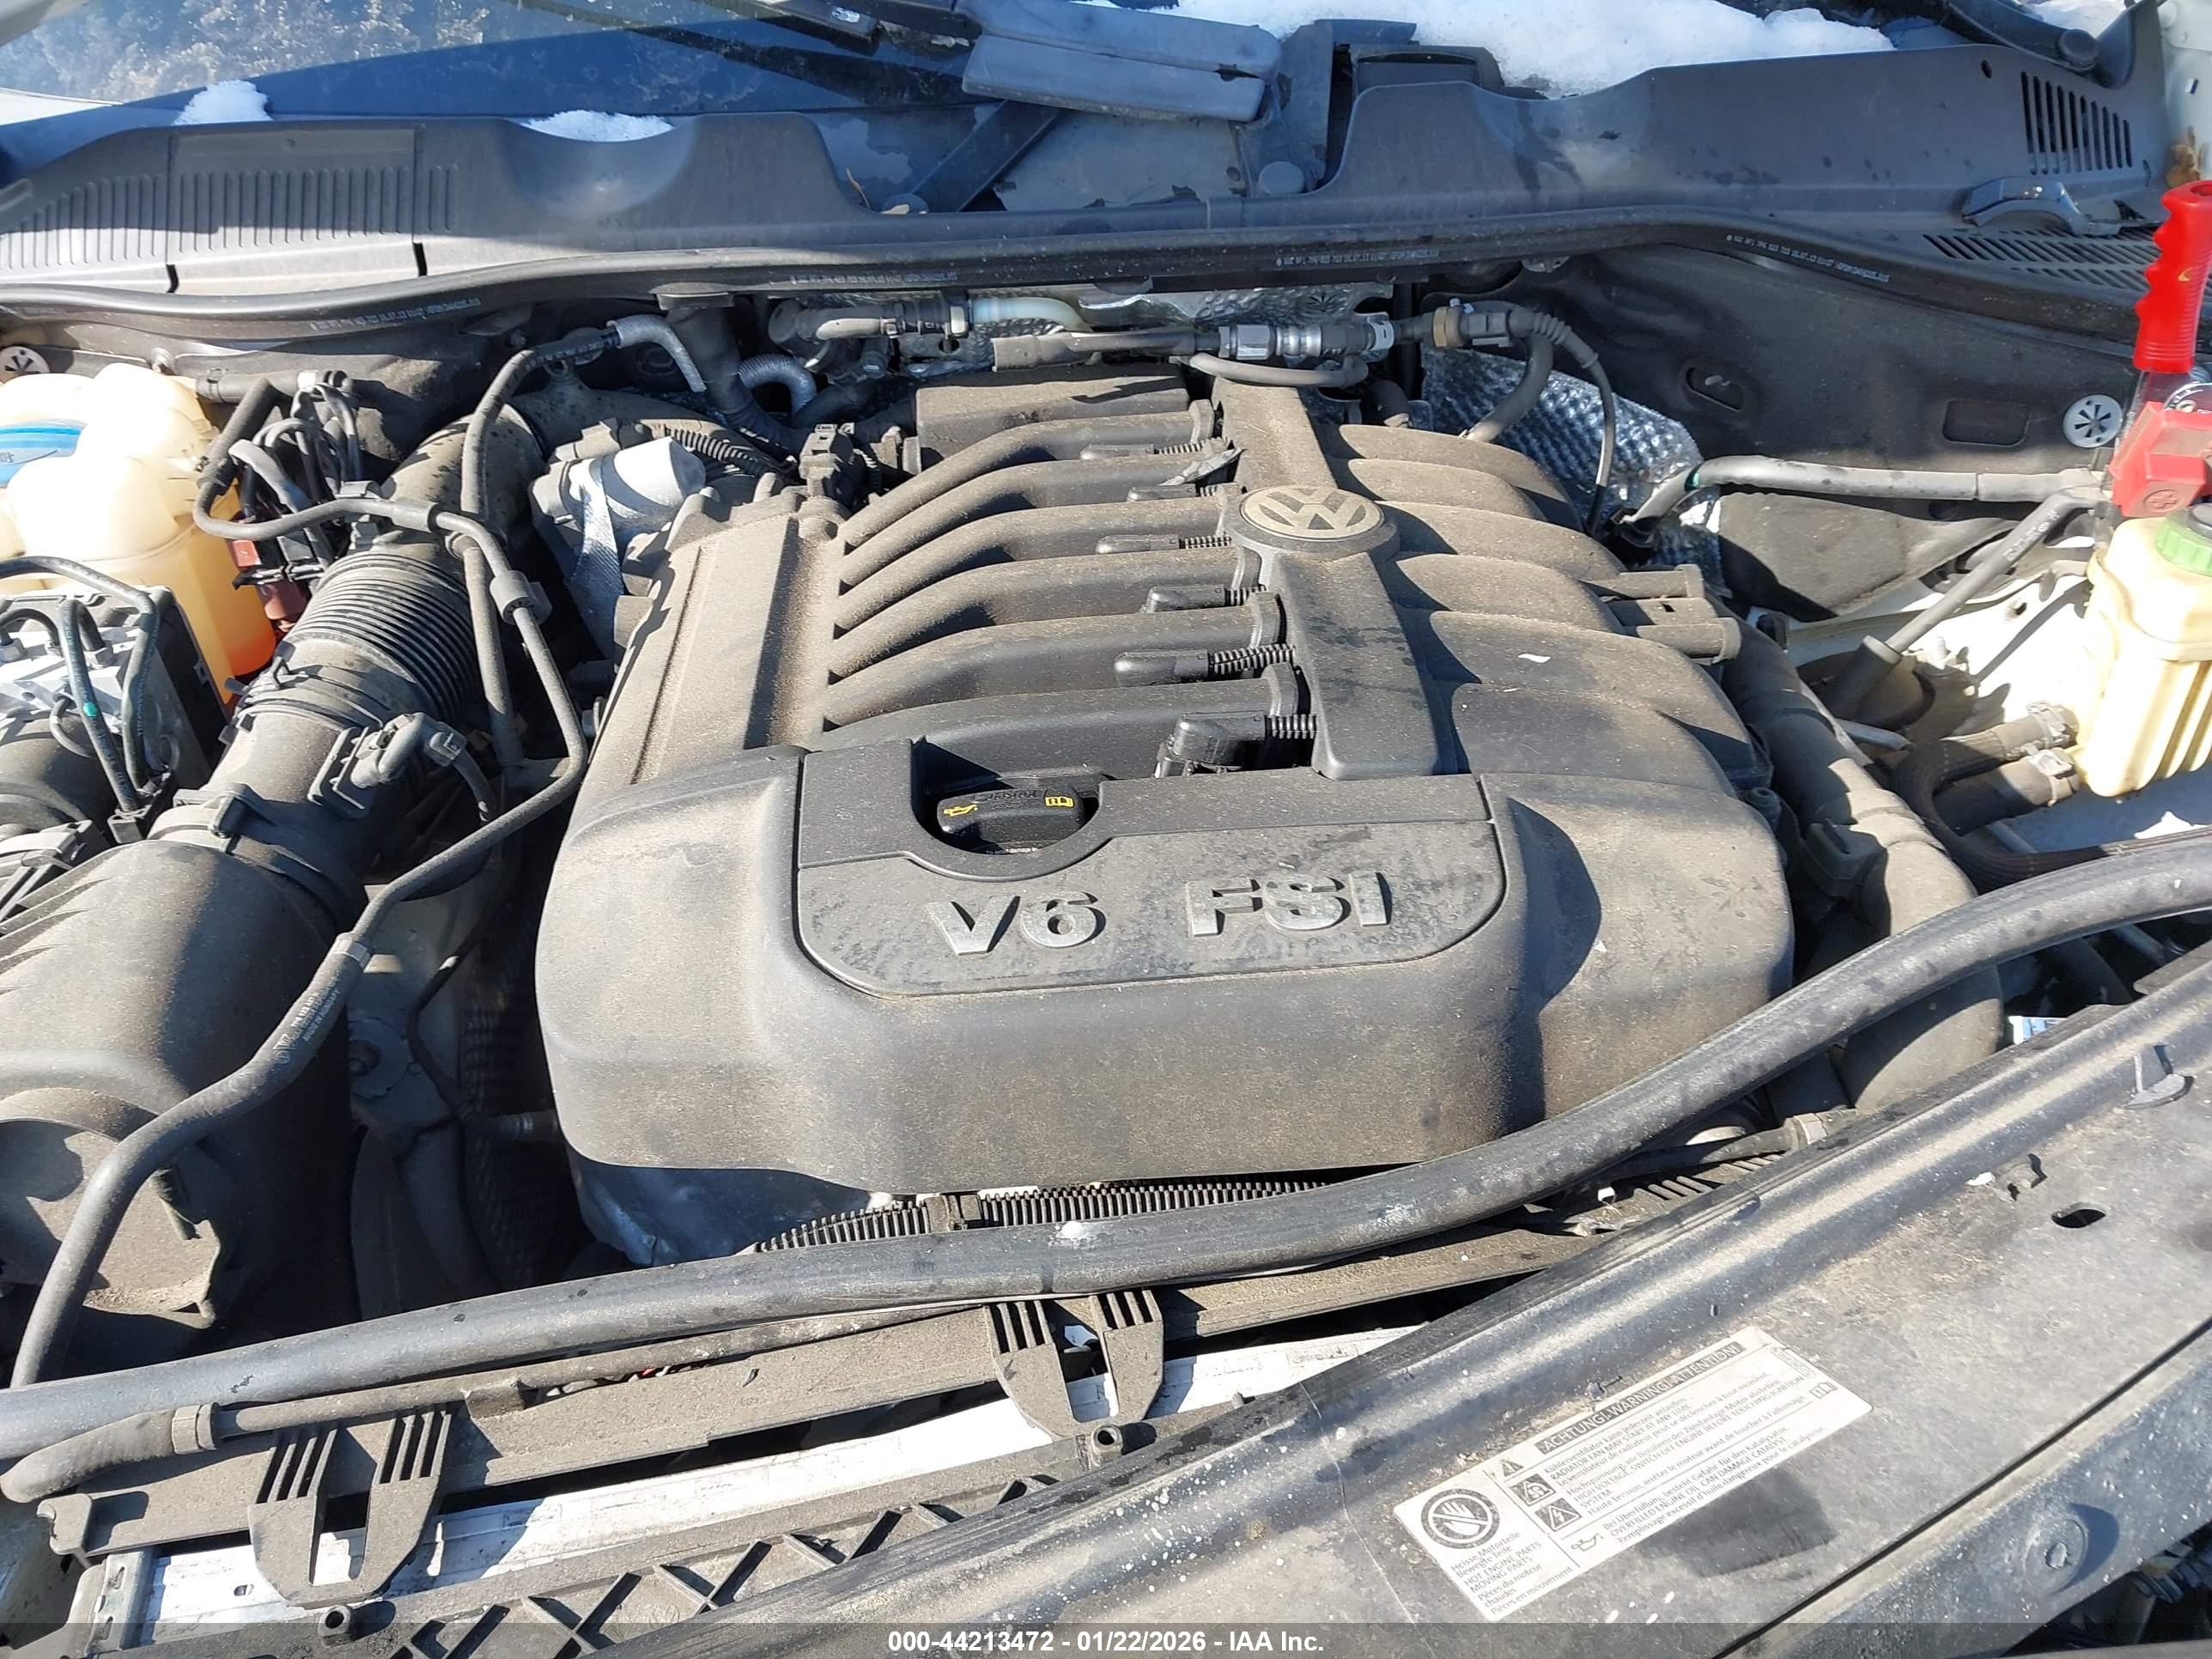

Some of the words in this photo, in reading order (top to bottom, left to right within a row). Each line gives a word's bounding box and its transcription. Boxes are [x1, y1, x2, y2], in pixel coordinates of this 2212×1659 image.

[924, 890, 1105, 957] V6
[1186, 872, 1393, 939] FSI
[1540, 1411, 1611, 1450] ACHTUNG!
[1606, 1379, 1674, 1416] WARNING!
[1668, 1344, 1741, 1383] ATTENTION!
[1723, 1395, 1749, 1411] Motor
[1549, 1456, 1591, 1480] RADIATOR
[1587, 1448, 1607, 1461] FAN
[1603, 1439, 1624, 1452] MAY
[1621, 1427, 1647, 1442] START
[1644, 1421, 1657, 1430] AT
[1653, 1413, 1674, 1425] ANY
[1571, 1486, 1597, 1502] HIGH
[1629, 1451, 1663, 1472] SWITCH
[1658, 1443, 1677, 1455] OFF
[1673, 1429, 1705, 1448] ENGINE
[1702, 1414, 1732, 1431] BEFORE
[1730, 1393, 1773, 1416] TOUCHING
[1767, 1375, 1805, 1396] IGNITION
[1606, 1450, 1620, 1460] de
[1616, 1433, 1653, 1455] radiateur
[1650, 1424, 1672, 1437] peut
[1721, 1388, 1739, 1399] tout
[1586, 1498, 1613, 1516] Haute
[1674, 1449, 1705, 1468] moteur
[1702, 1438, 1725, 1452] avant
[1722, 1432, 1735, 1441] de
[1732, 1417, 1764, 1436] toucher
[1689, 1462, 1720, 1481] Gefahr
[1717, 1455, 1733, 1466] für
[1729, 1448, 1747, 1459] den
[1608, 1508, 1657, 1537] OVERFILLED
[1654, 1492, 1686, 1511] ENGINE
[1683, 1484, 1701, 1495] OIL
[1698, 1474, 1720, 1487] CAN
[1716, 1455, 1753, 1477] DAMAGE
[1616, 1514, 1668, 1545] Remplissage
[1760, 1450, 1783, 1464] pour
[1462, 1571, 1484, 1586] HOT
[1482, 1554, 1516, 1576] ENGINE
[1514, 1540, 1542, 1558] PARTS
[1476, 1530, 1522, 1557] Motorteile
[1491, 1544, 1513, 1559] Teile
[1469, 1569, 1507, 1592] MOVING
[1505, 1554, 1534, 1572] PARTS
[1500, 1577, 1515, 1589] du
[1511, 1562, 1543, 1582] moteur
[1514, 1592, 1527, 1601] en
[1524, 1565, 1574, 1595] mouvement
[1482, 1585, 1518, 1608] chaudes
